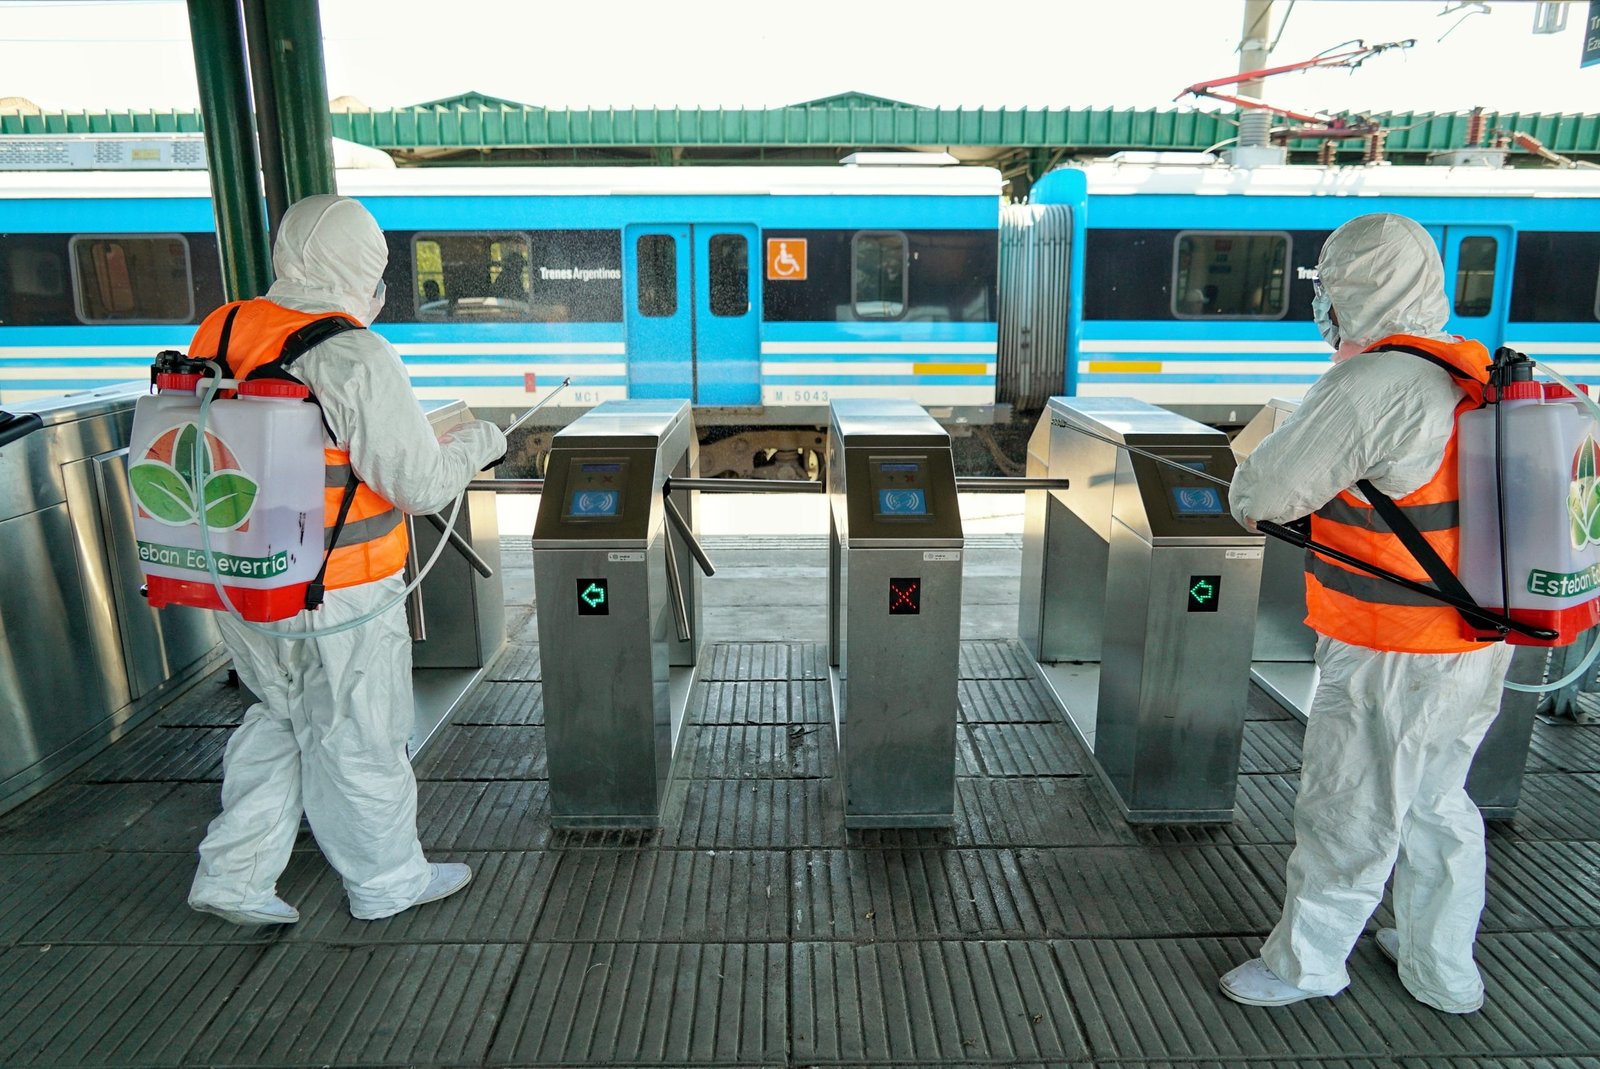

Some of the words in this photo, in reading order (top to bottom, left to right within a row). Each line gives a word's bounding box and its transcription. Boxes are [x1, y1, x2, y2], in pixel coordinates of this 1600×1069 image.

[540, 266, 573, 280] Trenes
[573, 266, 621, 281] Argentinos
[794, 390, 829, 402] 5043
[1531, 572, 1592, 596] Esteban
